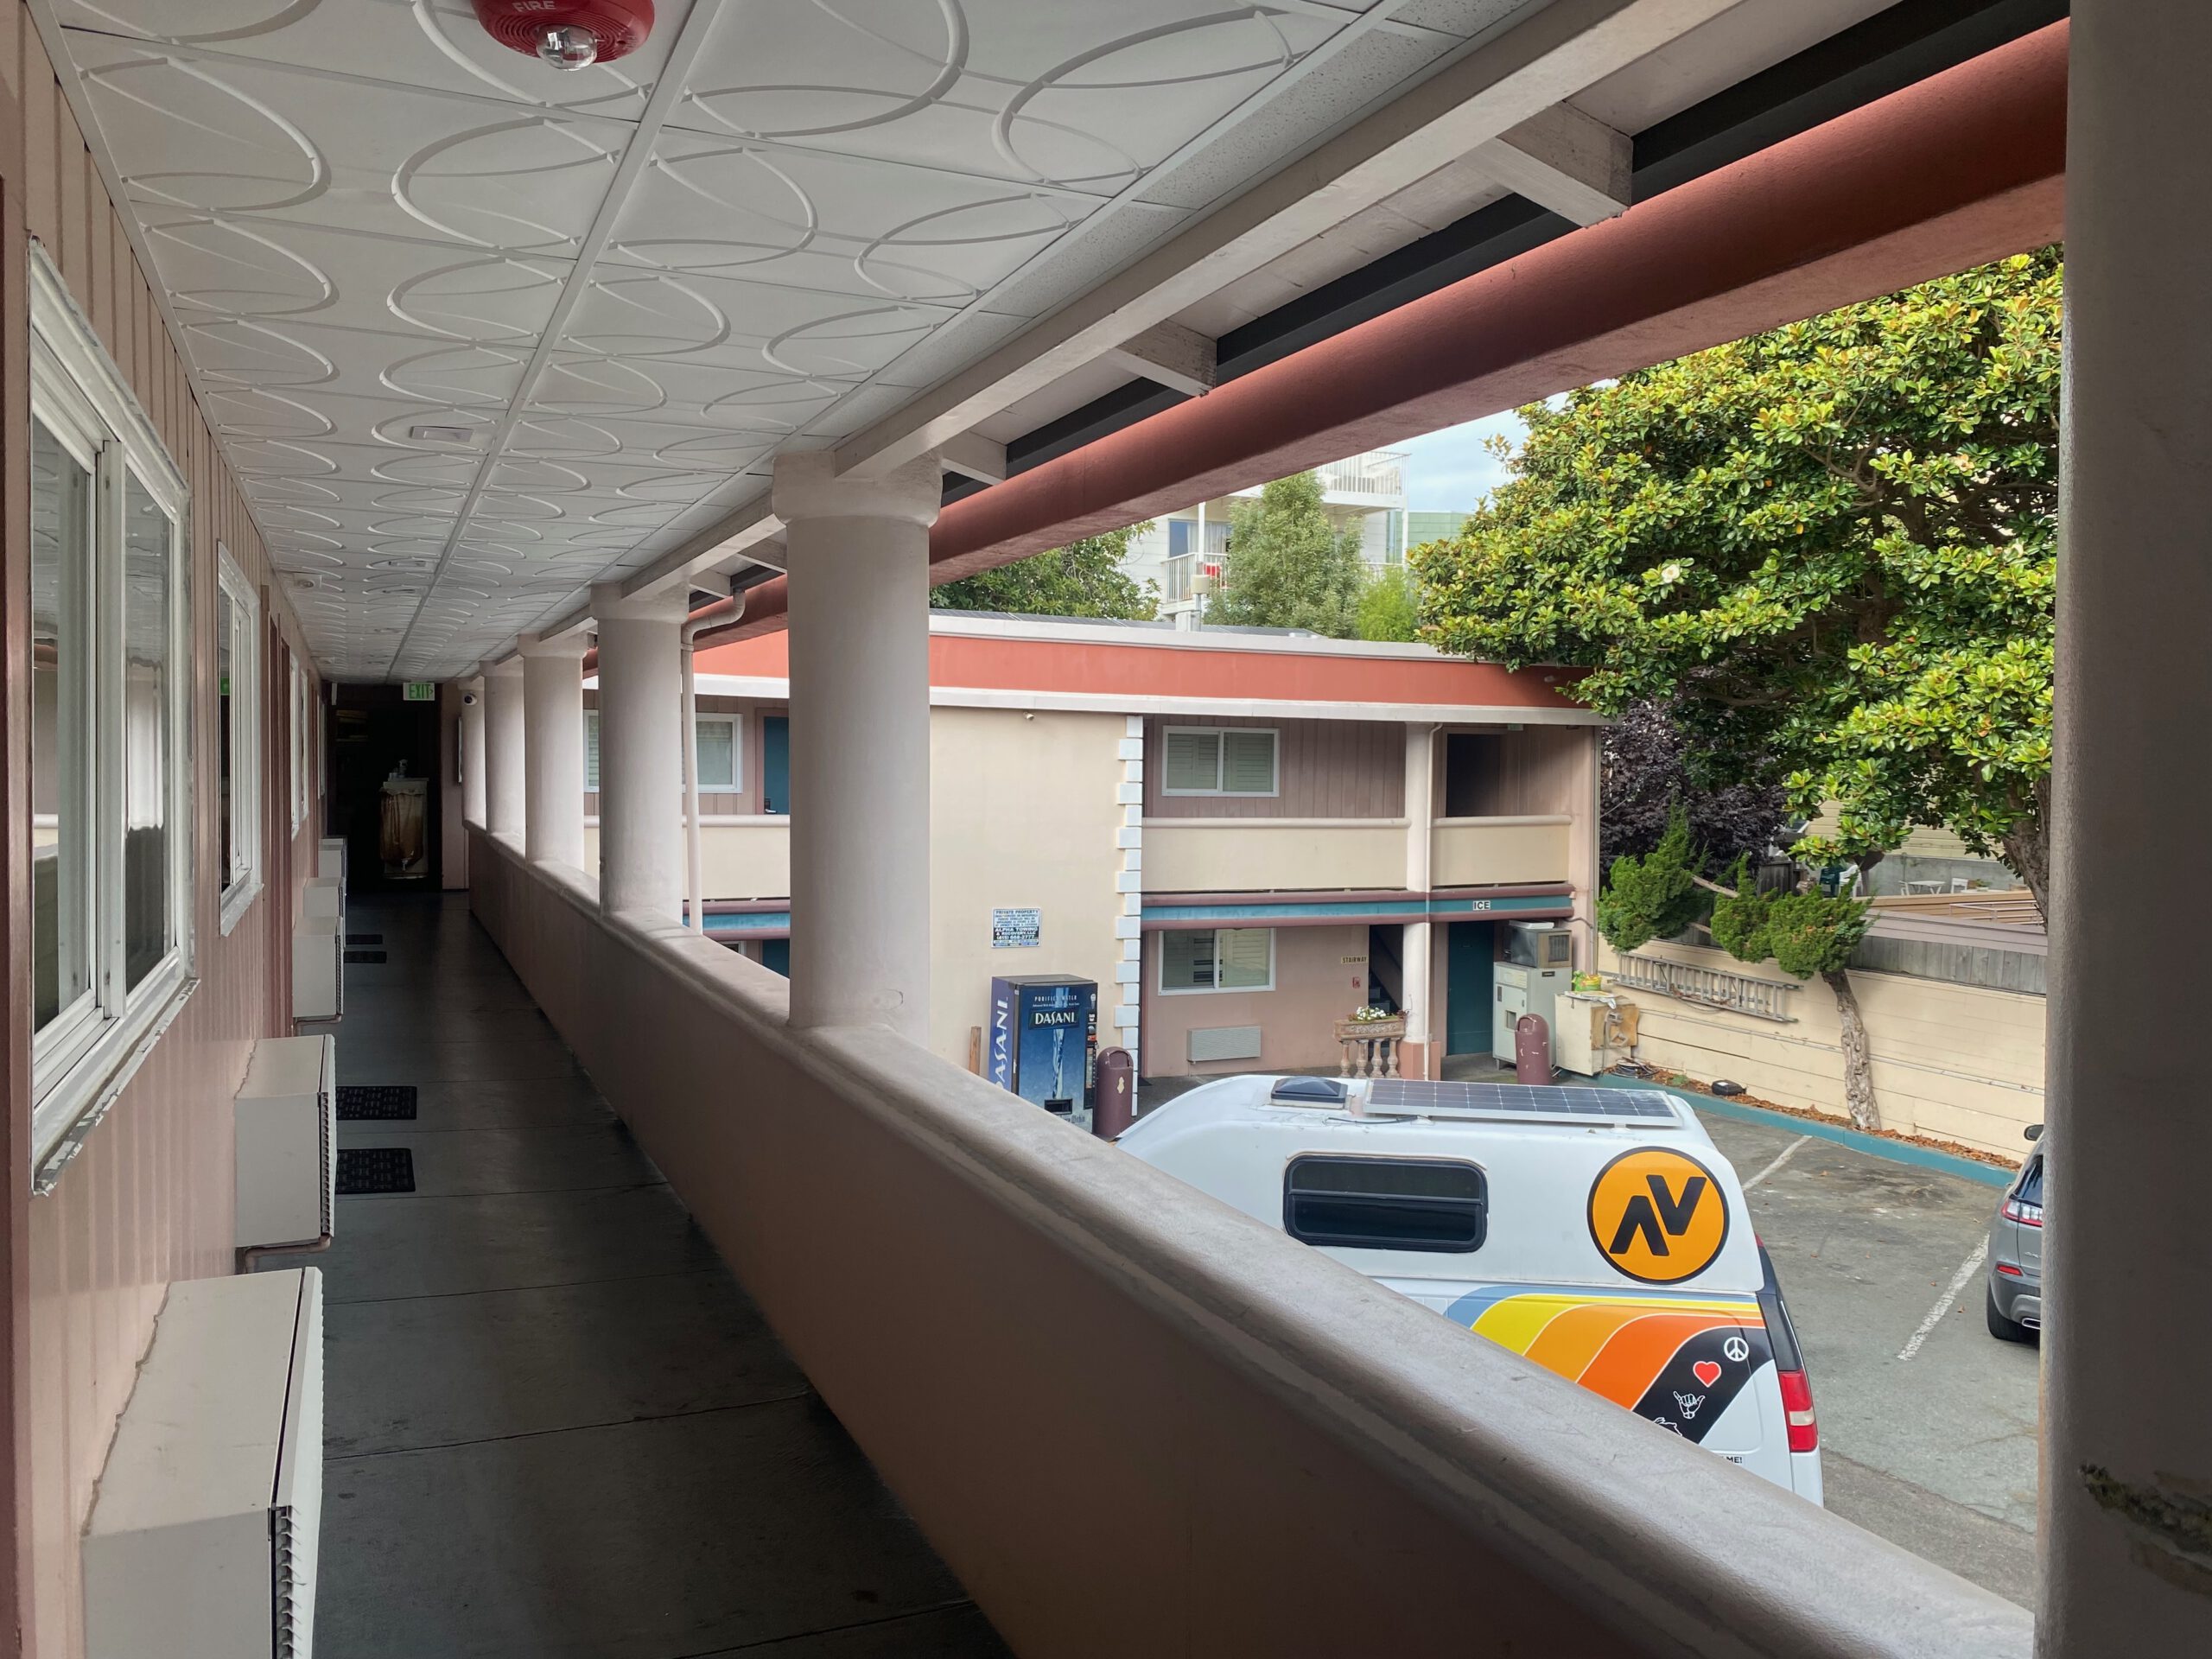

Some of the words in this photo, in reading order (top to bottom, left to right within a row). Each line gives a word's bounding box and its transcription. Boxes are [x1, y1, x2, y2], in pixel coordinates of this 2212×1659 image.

[512, 0, 556, 12] FIRE
[409, 683, 430, 699] EXIT
[1034, 1011, 1075, 1026] DASANI
